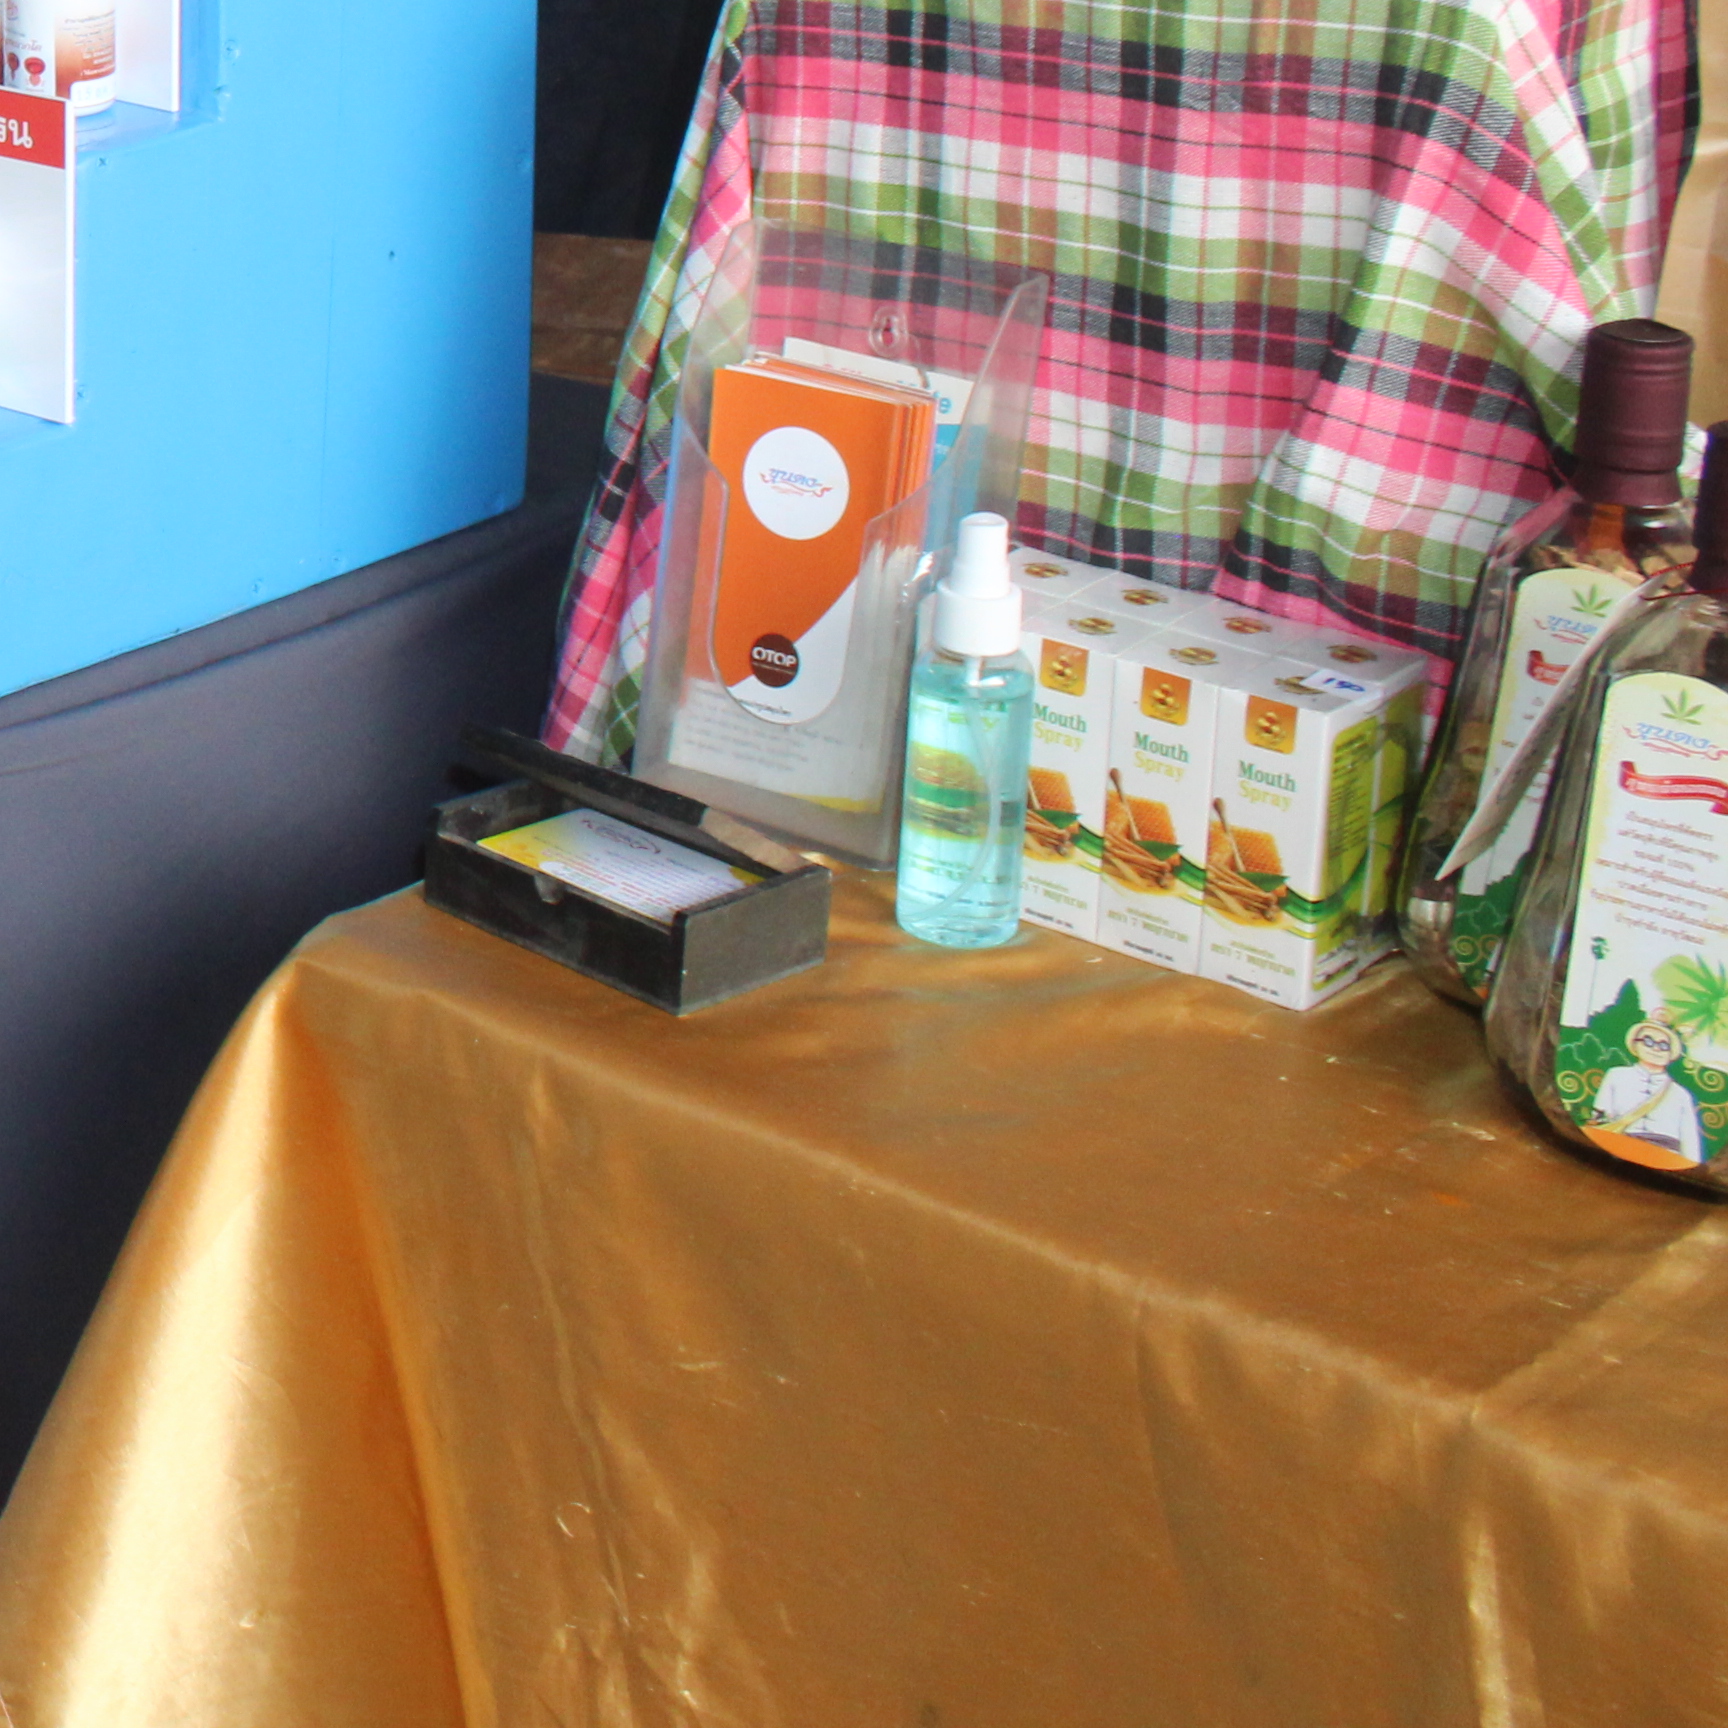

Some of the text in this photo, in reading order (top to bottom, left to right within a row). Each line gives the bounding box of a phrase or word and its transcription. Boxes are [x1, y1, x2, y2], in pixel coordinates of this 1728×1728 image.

[751, 645, 799, 669] OTOP
[1033, 701, 1088, 734] Mouth
[1134, 731, 1190, 764] Mouth
[1134, 750, 1186, 783] Spray
[1237, 760, 1297, 792] Mouth
[1237, 779, 1293, 813] Spray
